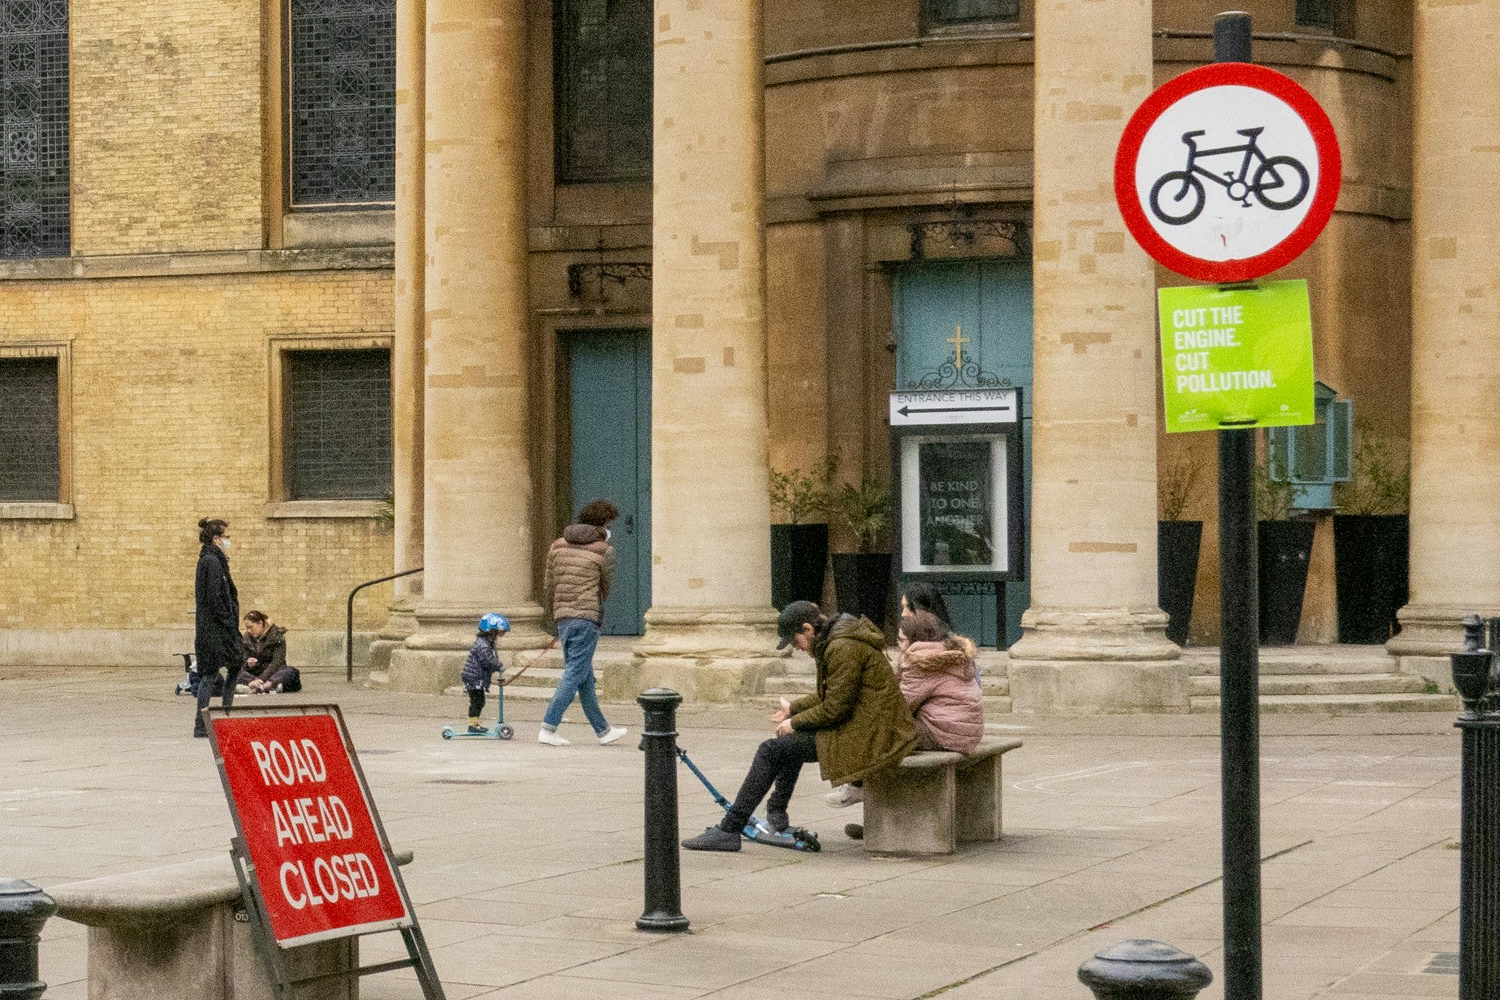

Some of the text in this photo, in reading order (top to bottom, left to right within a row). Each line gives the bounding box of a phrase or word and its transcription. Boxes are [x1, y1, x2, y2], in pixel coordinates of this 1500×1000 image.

[1172, 305, 1243, 328] CUT THE
[1174, 328, 1242, 350] ENGINE.
[1175, 351, 1210, 372] CUT
[1176, 370, 1276, 393] POLLUTION.
[897, 391, 1009, 404] ENTRANCE THIS WAY
[930, 480, 978, 492] BE KIND
[929, 497, 980, 509] TO ONE
[250, 738, 327, 786] ROAD
[271, 795, 353, 848] AHEAD
[279, 852, 380, 910] CLOSED
[235, 912, 249, 921] 013
